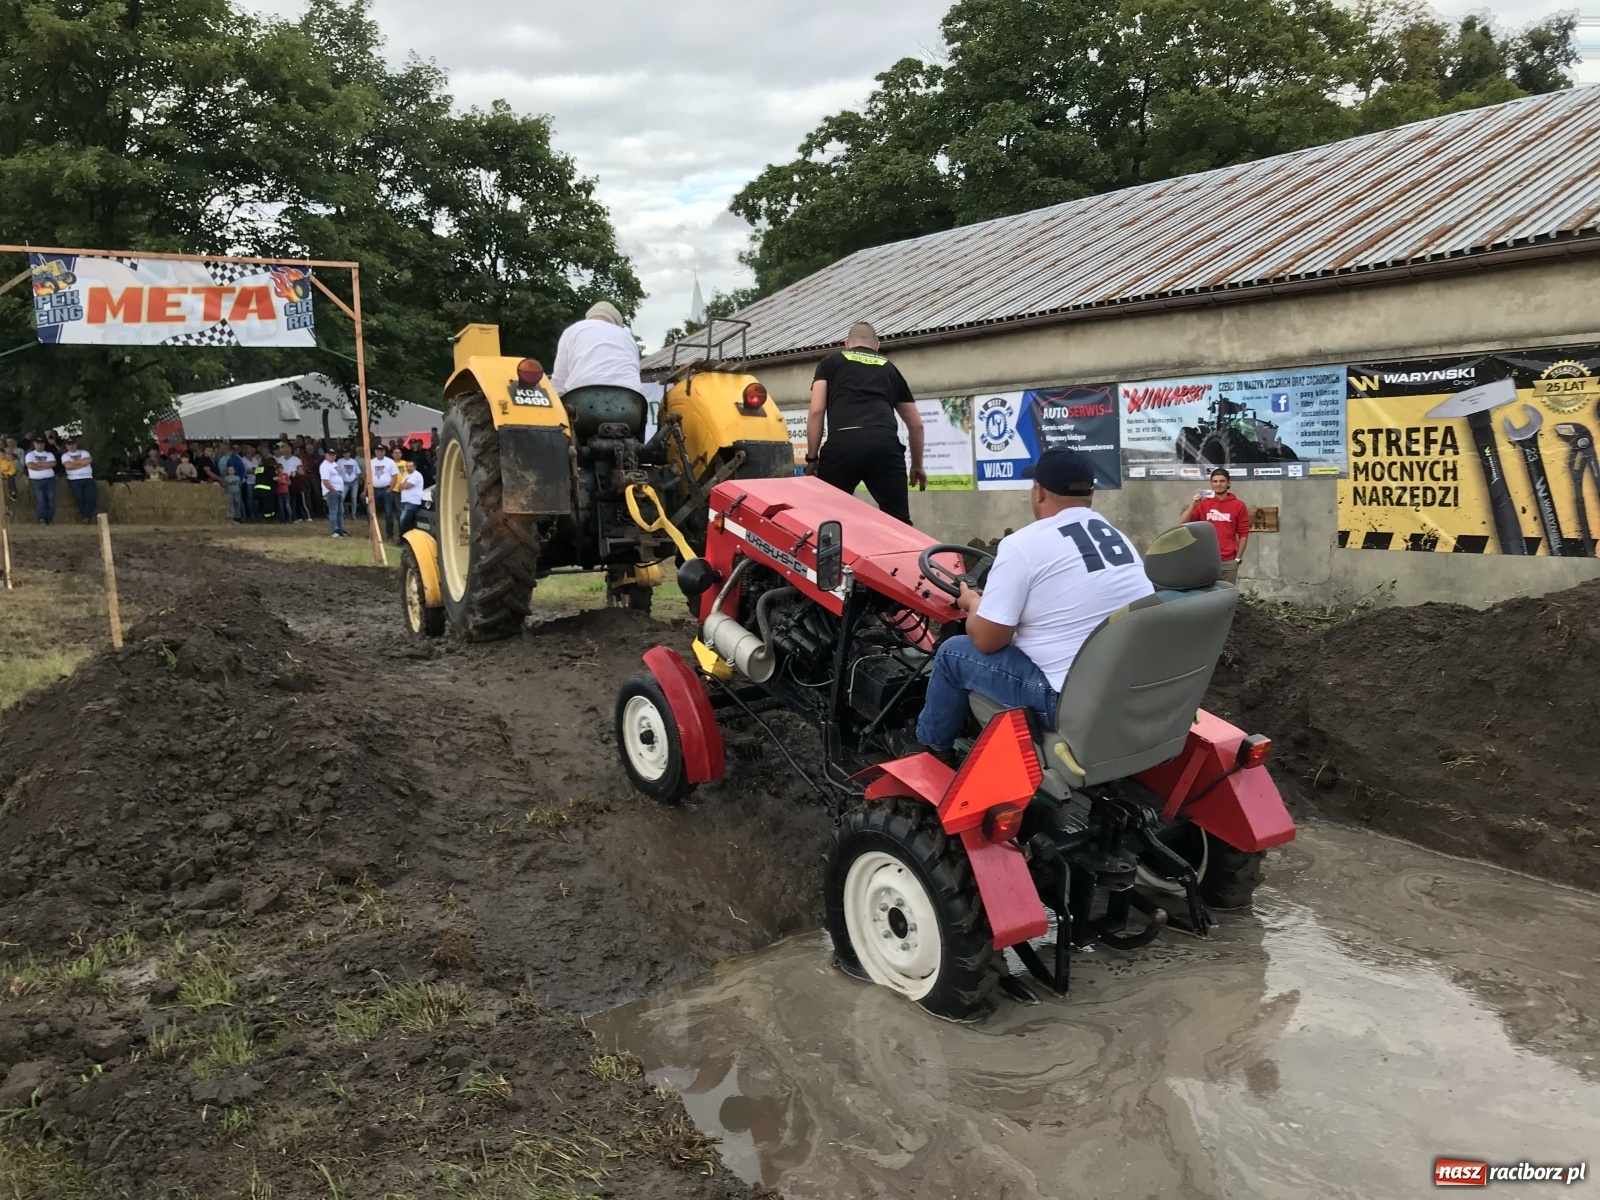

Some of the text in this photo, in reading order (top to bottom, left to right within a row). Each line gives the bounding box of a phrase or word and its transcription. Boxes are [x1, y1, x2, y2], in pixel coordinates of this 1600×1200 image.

[34, 290, 80, 310] PEK
[86, 285, 277, 324] META
[287, 314, 314, 330] RA
[1265, 378, 1291, 389] POLSKICH
[1546, 381, 1587, 392] 25 LAT
[516, 389, 543, 397] KCA
[1300, 391, 1313, 399] pasy
[515, 396, 550, 406] 9490
[987, 399, 1002, 407] WEST
[1043, 404, 1105, 420] AUTOSERWIS
[785, 416, 807, 425] ontakt
[1300, 420, 1315, 428] oleje
[1300, 429, 1339, 437] akumulatory
[1352, 426, 1459, 457] STREFA
[1525, 447, 1538, 462] 23
[983, 462, 1013, 478] WJAZD
[1353, 460, 1458, 481] MOCNYCH
[1353, 486, 1459, 512] NARZĘDZI
[1057, 518, 1135, 573] 18
